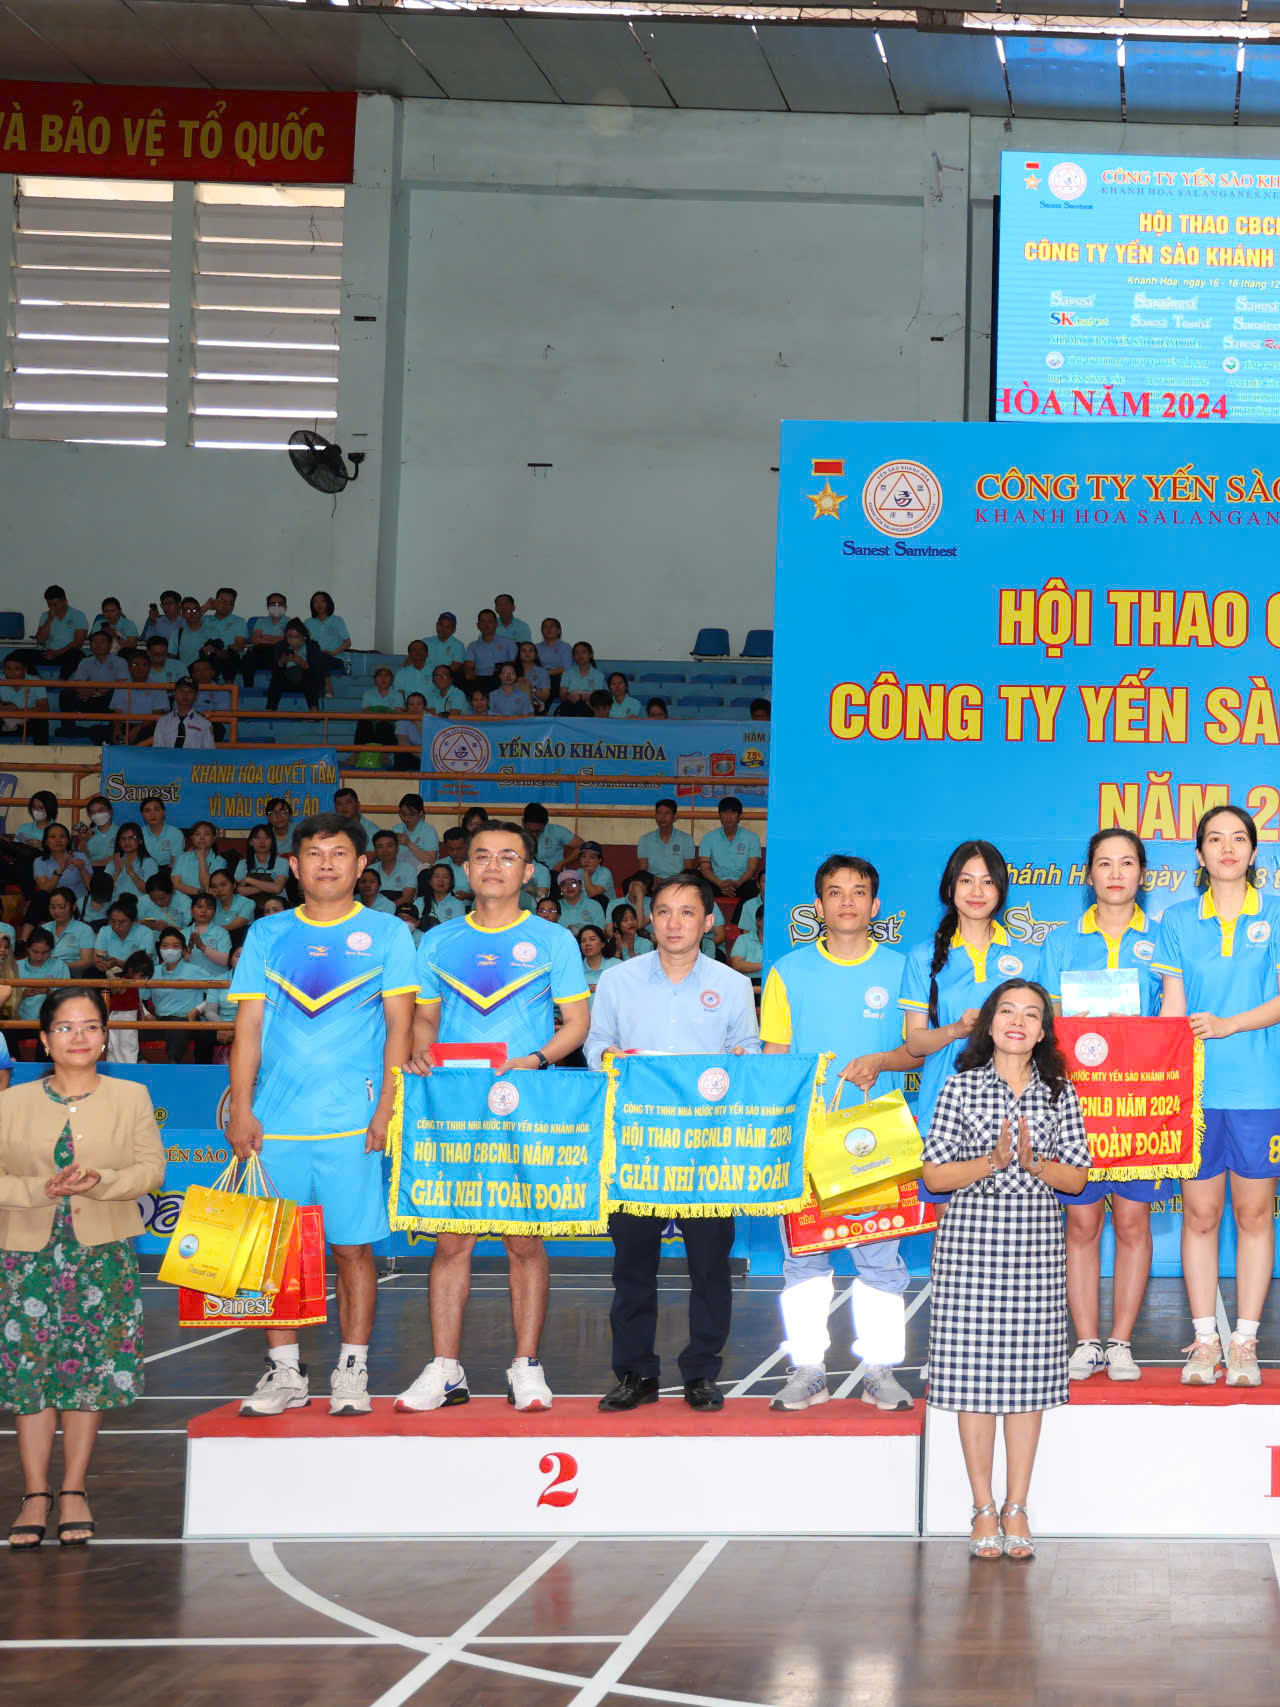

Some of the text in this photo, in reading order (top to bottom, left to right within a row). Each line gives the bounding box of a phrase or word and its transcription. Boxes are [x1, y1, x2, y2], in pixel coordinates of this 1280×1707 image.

[0, 101, 324, 167] À BẢO VỆ TỔ QUỐC
[1102, 168, 1149, 185] CÔNG
[1154, 172, 1176, 185] TY
[1182, 168, 1216, 188] YẾN
[1220, 172, 1253, 188] SÀO
[1139, 209, 1172, 237] HỘI
[1179, 214, 1229, 234] THAO
[1024, 238, 1080, 263] CÔNG
[1086, 243, 1109, 263] TY
[1114, 239, 1154, 264] YẾN
[1160, 242, 1200, 266] SÀO
[1206, 243, 1274, 268] KHÁNH
[1072, 384, 1151, 417] NĂM
[1162, 392, 1228, 419] 2024
[975, 466, 1079, 502] CÔNG
[1086, 474, 1136, 501] TY
[1143, 463, 1219, 502] YẾN
[975, 508, 1065, 523] KHANH
[1076, 509, 1128, 524] HOA
[843, 540, 957, 556] Sanest Sanvinest
[998, 576, 1092, 659] HỘI
[1107, 589, 1248, 653] THAO
[829, 670, 984, 742] CÔNG
[998, 683, 1067, 742] TY
[1079, 667, 1190, 743] YẾN
[498, 736, 667, 761] YẾN SÀO KHÁNH HÒA
[106, 770, 183, 802] Sanest
[191, 761, 236, 784] KHÁNH
[238, 761, 264, 784] HÒA
[266, 759, 306, 784] QUYẾT
[208, 792, 320, 817] VÌ MÀU ÁO
[1007, 863, 1062, 886] hánh
[1142, 865, 1186, 892] gày
[1080, 1093, 1180, 1118] CNLĐ NĂM 2024
[622, 1122, 644, 1151] HỘI
[648, 1126, 681, 1148] THAO
[736, 1124, 766, 1148] NĂM
[770, 1126, 793, 1147] 2024
[1088, 1124, 1182, 1158] TOÀN ĐOÀN
[193, 1146, 228, 1162] SÀO
[414, 1138, 589, 1167] HỘI THAO CBCNLĐ NĂM 2024
[619, 1155, 660, 1191] GIẢI
[697, 1157, 745, 1191] TOÀN
[748, 1157, 790, 1191] ĐOÀN
[411, 1171, 452, 1206] GIẢI
[487, 1175, 532, 1208] TOÀN
[535, 1176, 587, 1209] ĐOÀN
[204, 1293, 276, 1319] Sanest
[536, 1451, 579, 1508] 2
